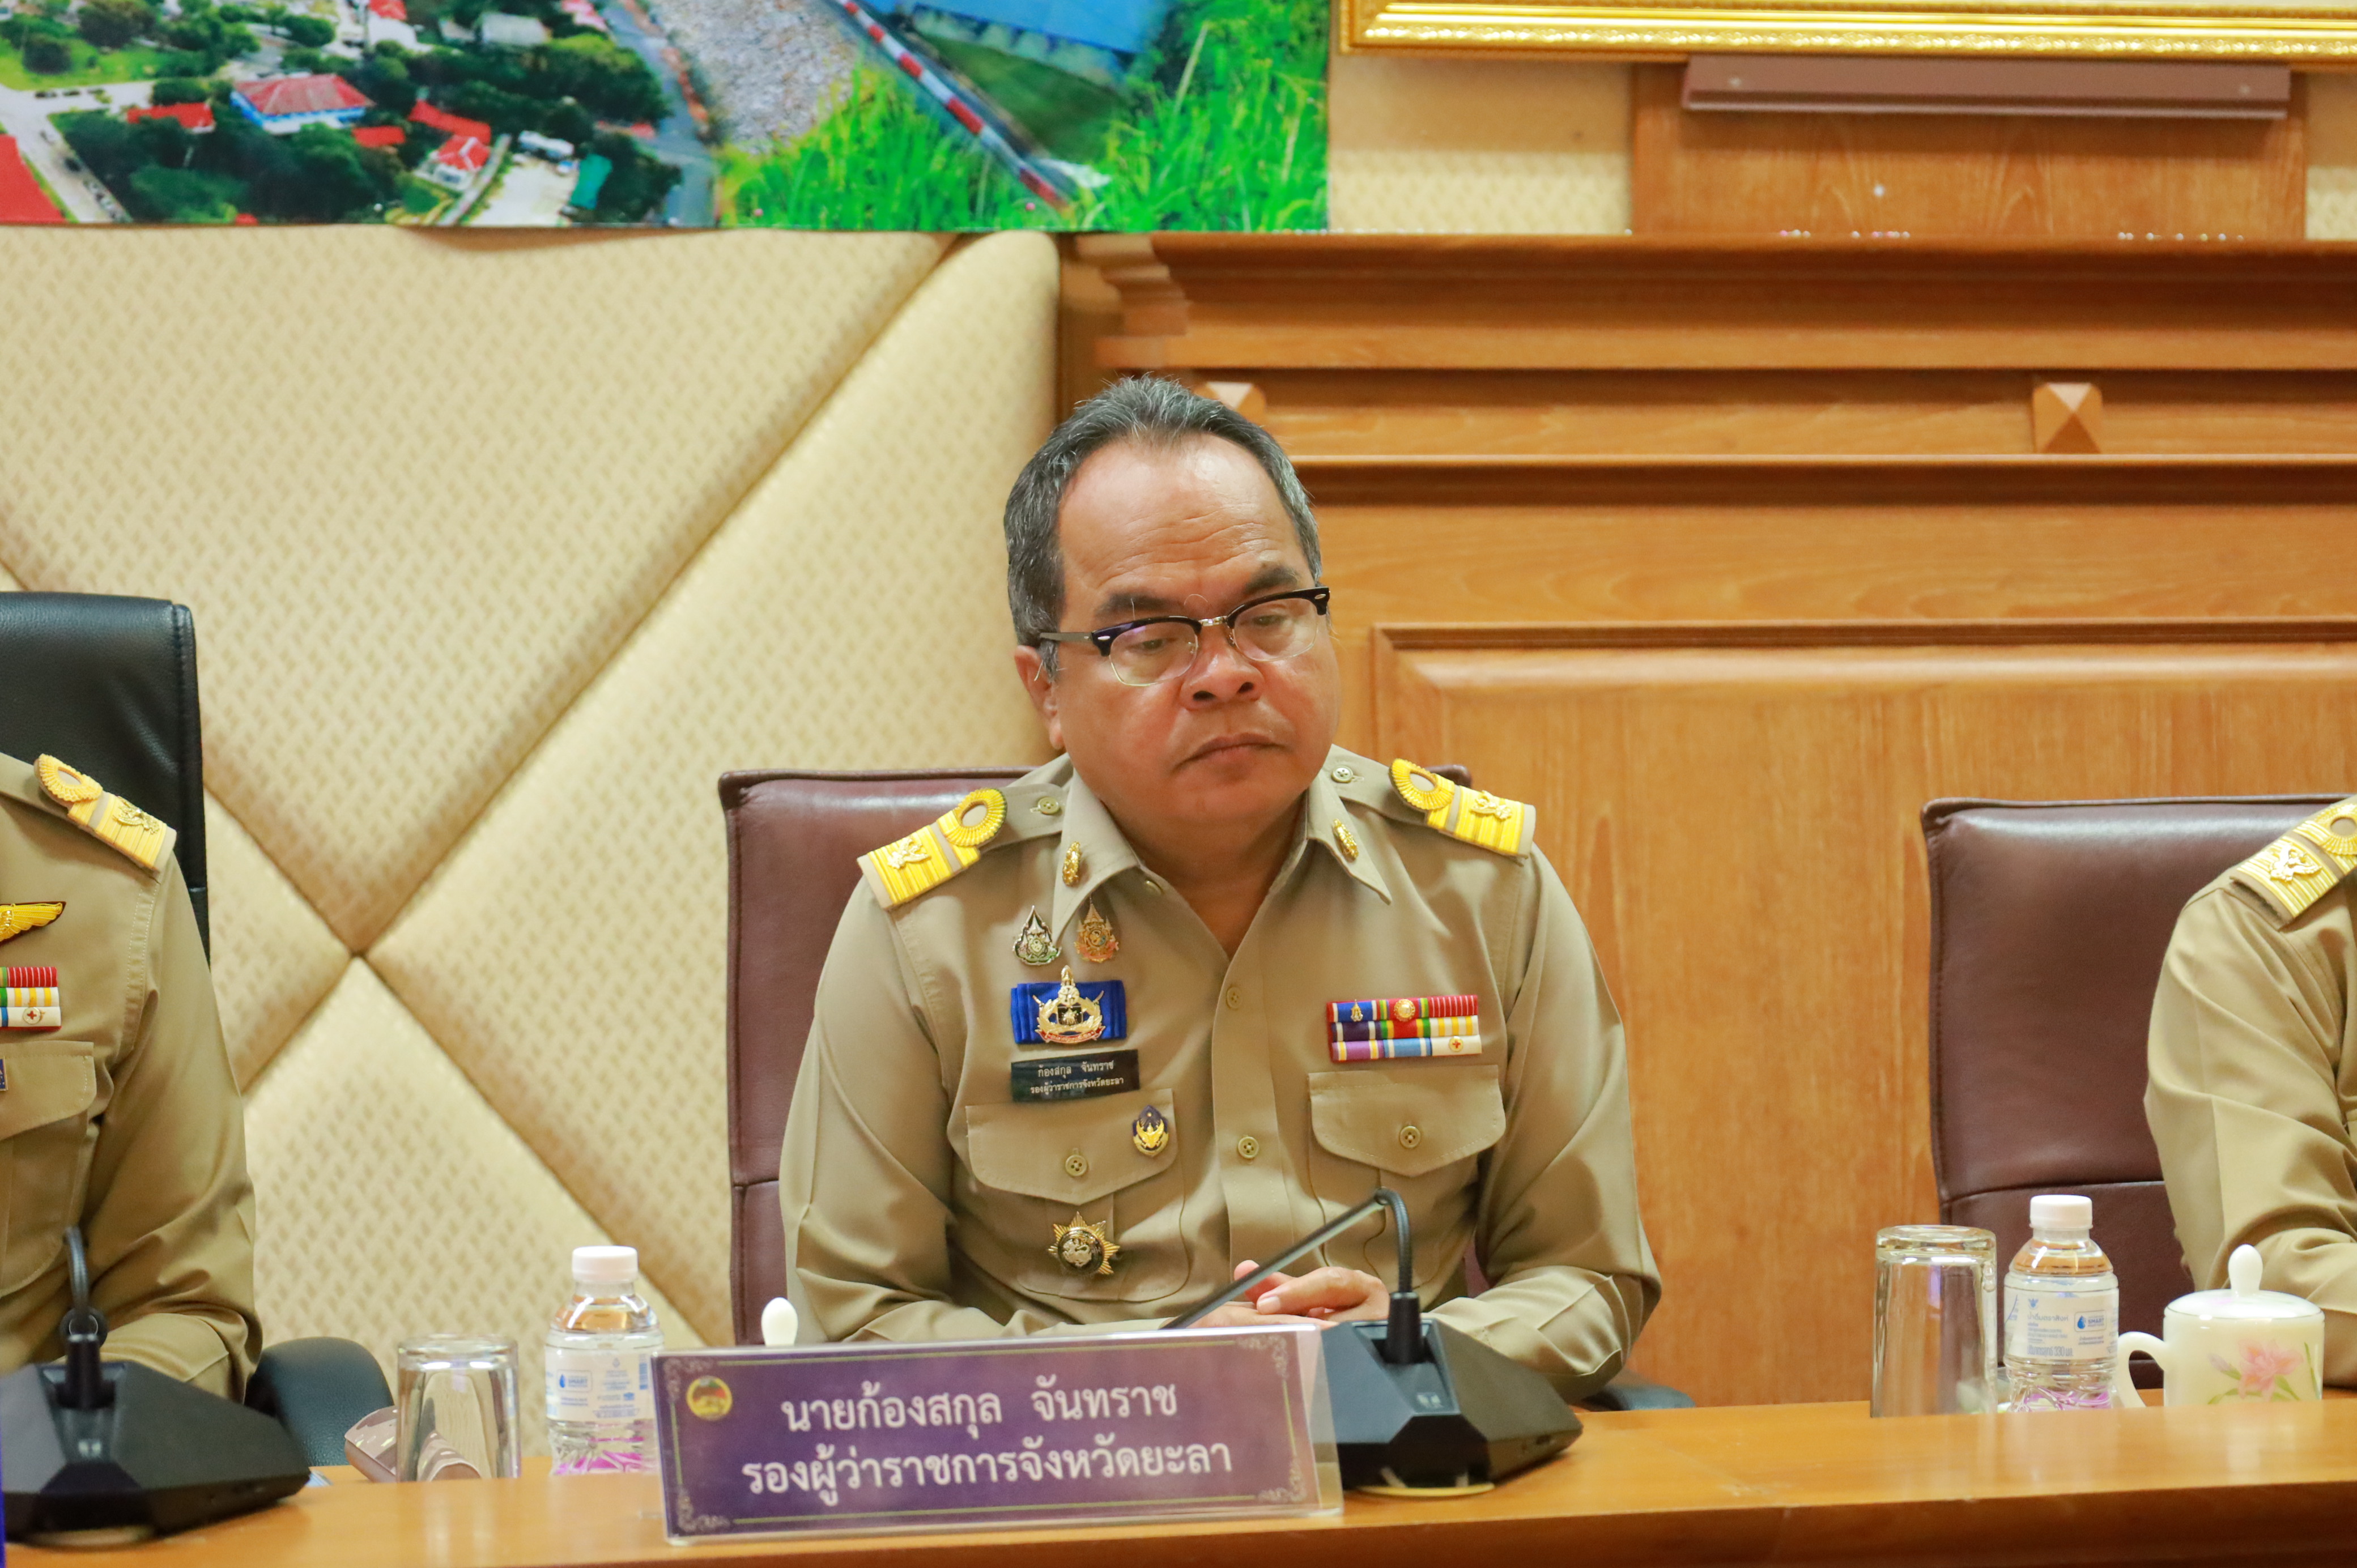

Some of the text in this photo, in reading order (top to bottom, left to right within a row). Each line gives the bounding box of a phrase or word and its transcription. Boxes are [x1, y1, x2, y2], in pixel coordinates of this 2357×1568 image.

[1030, 1077, 1124, 1095] รองผู้ว่าราชการจังหวัดยะลา
[1038, 1060, 1114, 1079] ก้องสกุล จันทราช
[781, 1373, 1177, 1439] นายก้องสกุล จันทราช
[741, 1431, 1232, 1507] รองผู้ว่าราชการจังหวัดยะลา
